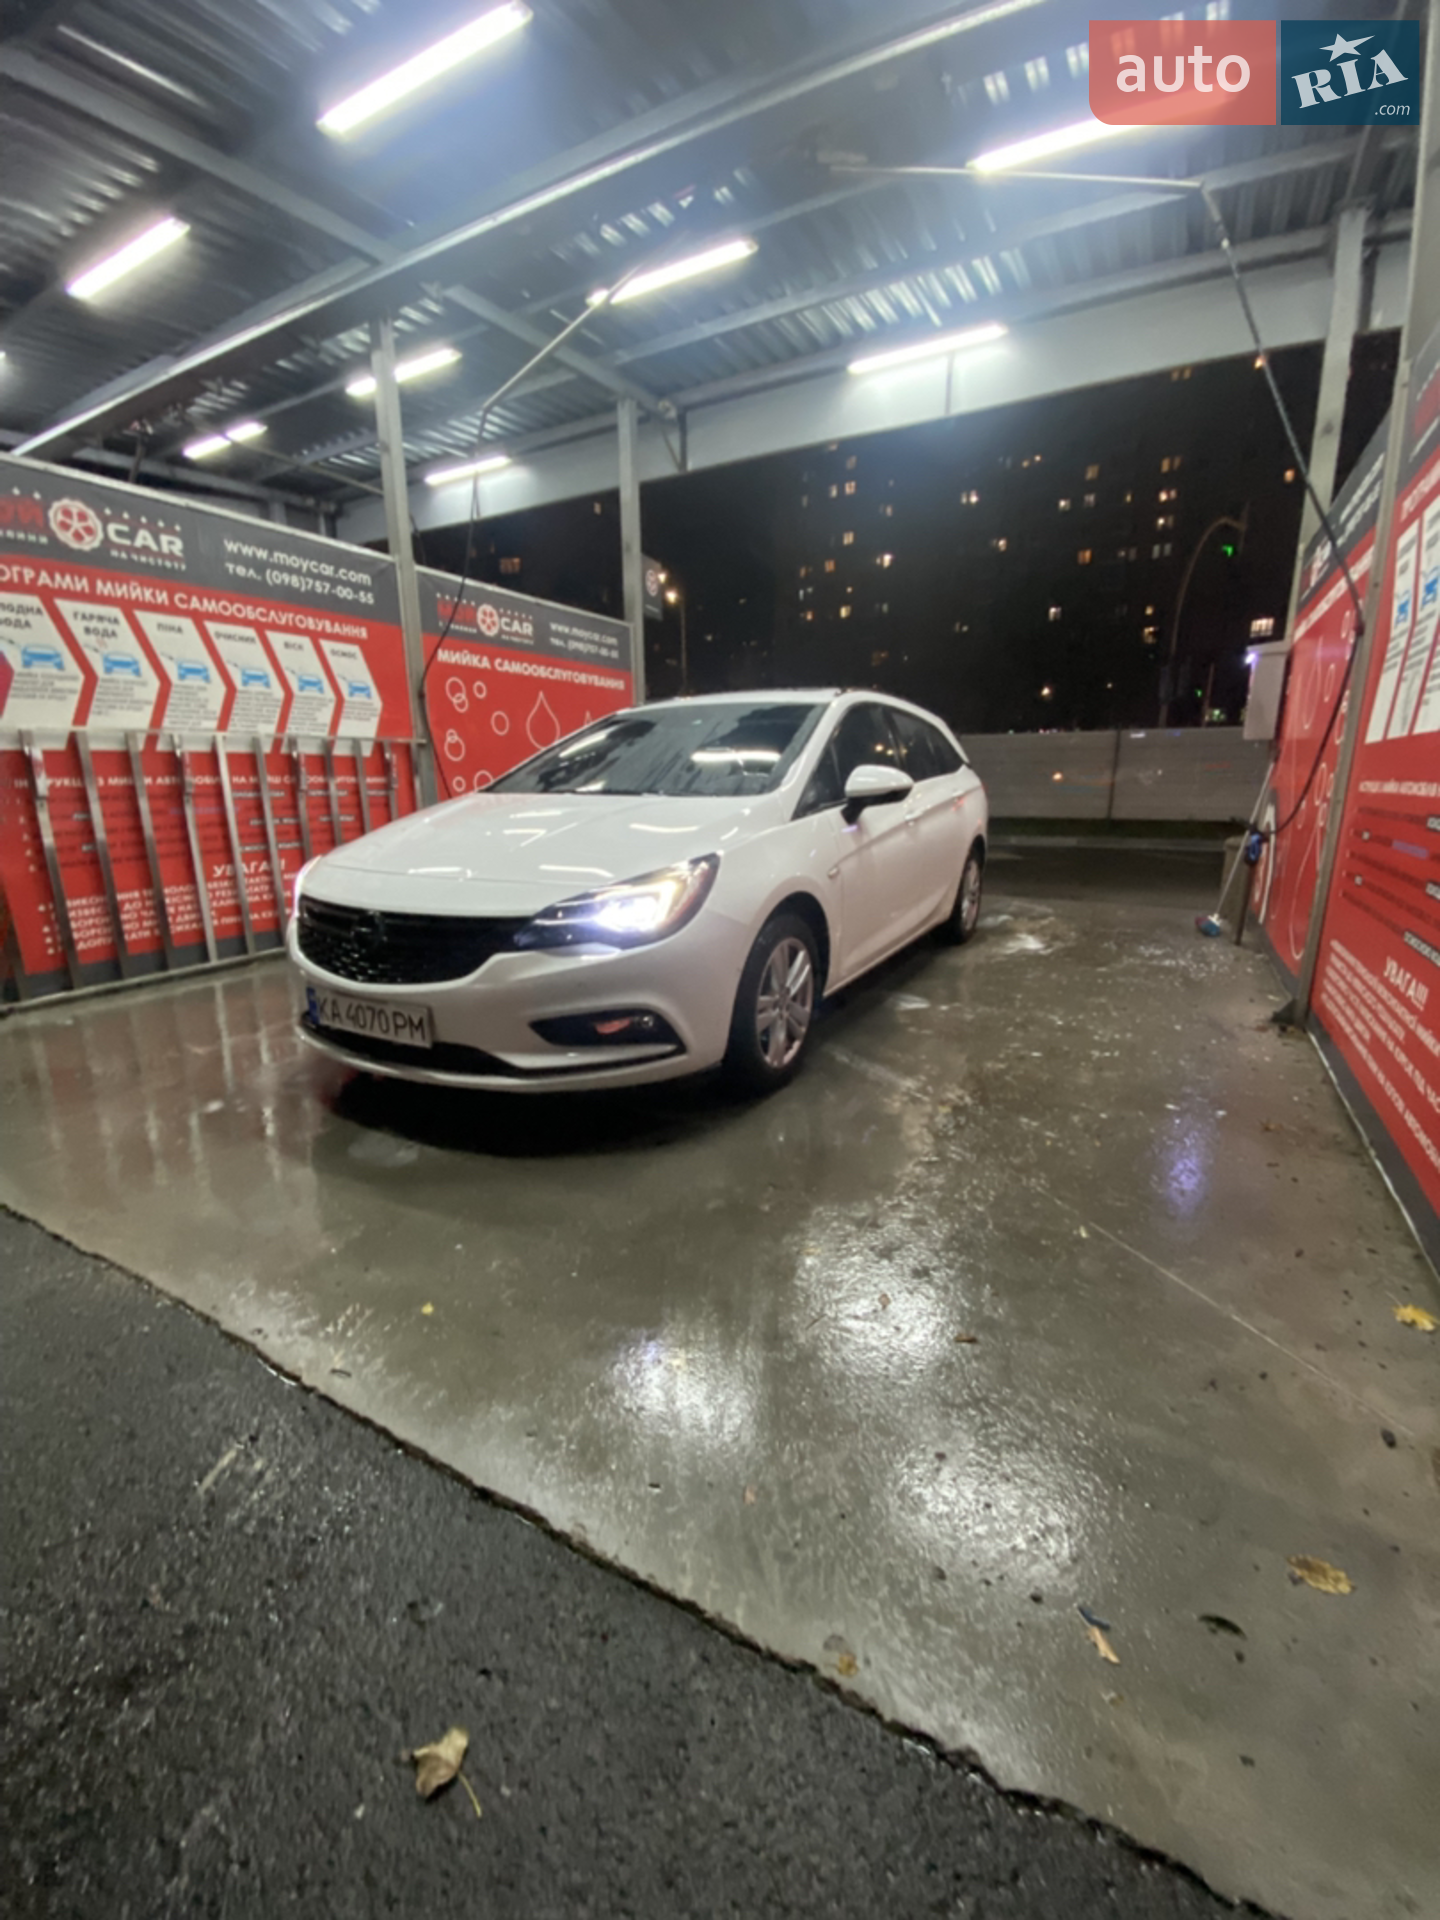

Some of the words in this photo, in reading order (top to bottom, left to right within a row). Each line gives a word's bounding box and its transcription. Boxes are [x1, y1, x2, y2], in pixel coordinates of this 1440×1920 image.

[106, 522, 185, 558] CAR
[223, 538, 373, 587] www.moycar.com
[95, 579, 170, 606] МИЙКИ
[173, 591, 369, 641] САМООБСЛУГОВУВАННЯ
[500, 616, 534, 637] CAR
[436, 646, 492, 671] МИЙКА
[493, 657, 626, 691] САМООБСЛУГОВУВАННЯ
[346, 1003, 390, 1034] 4070
[394, 1011, 426, 1041] PM
